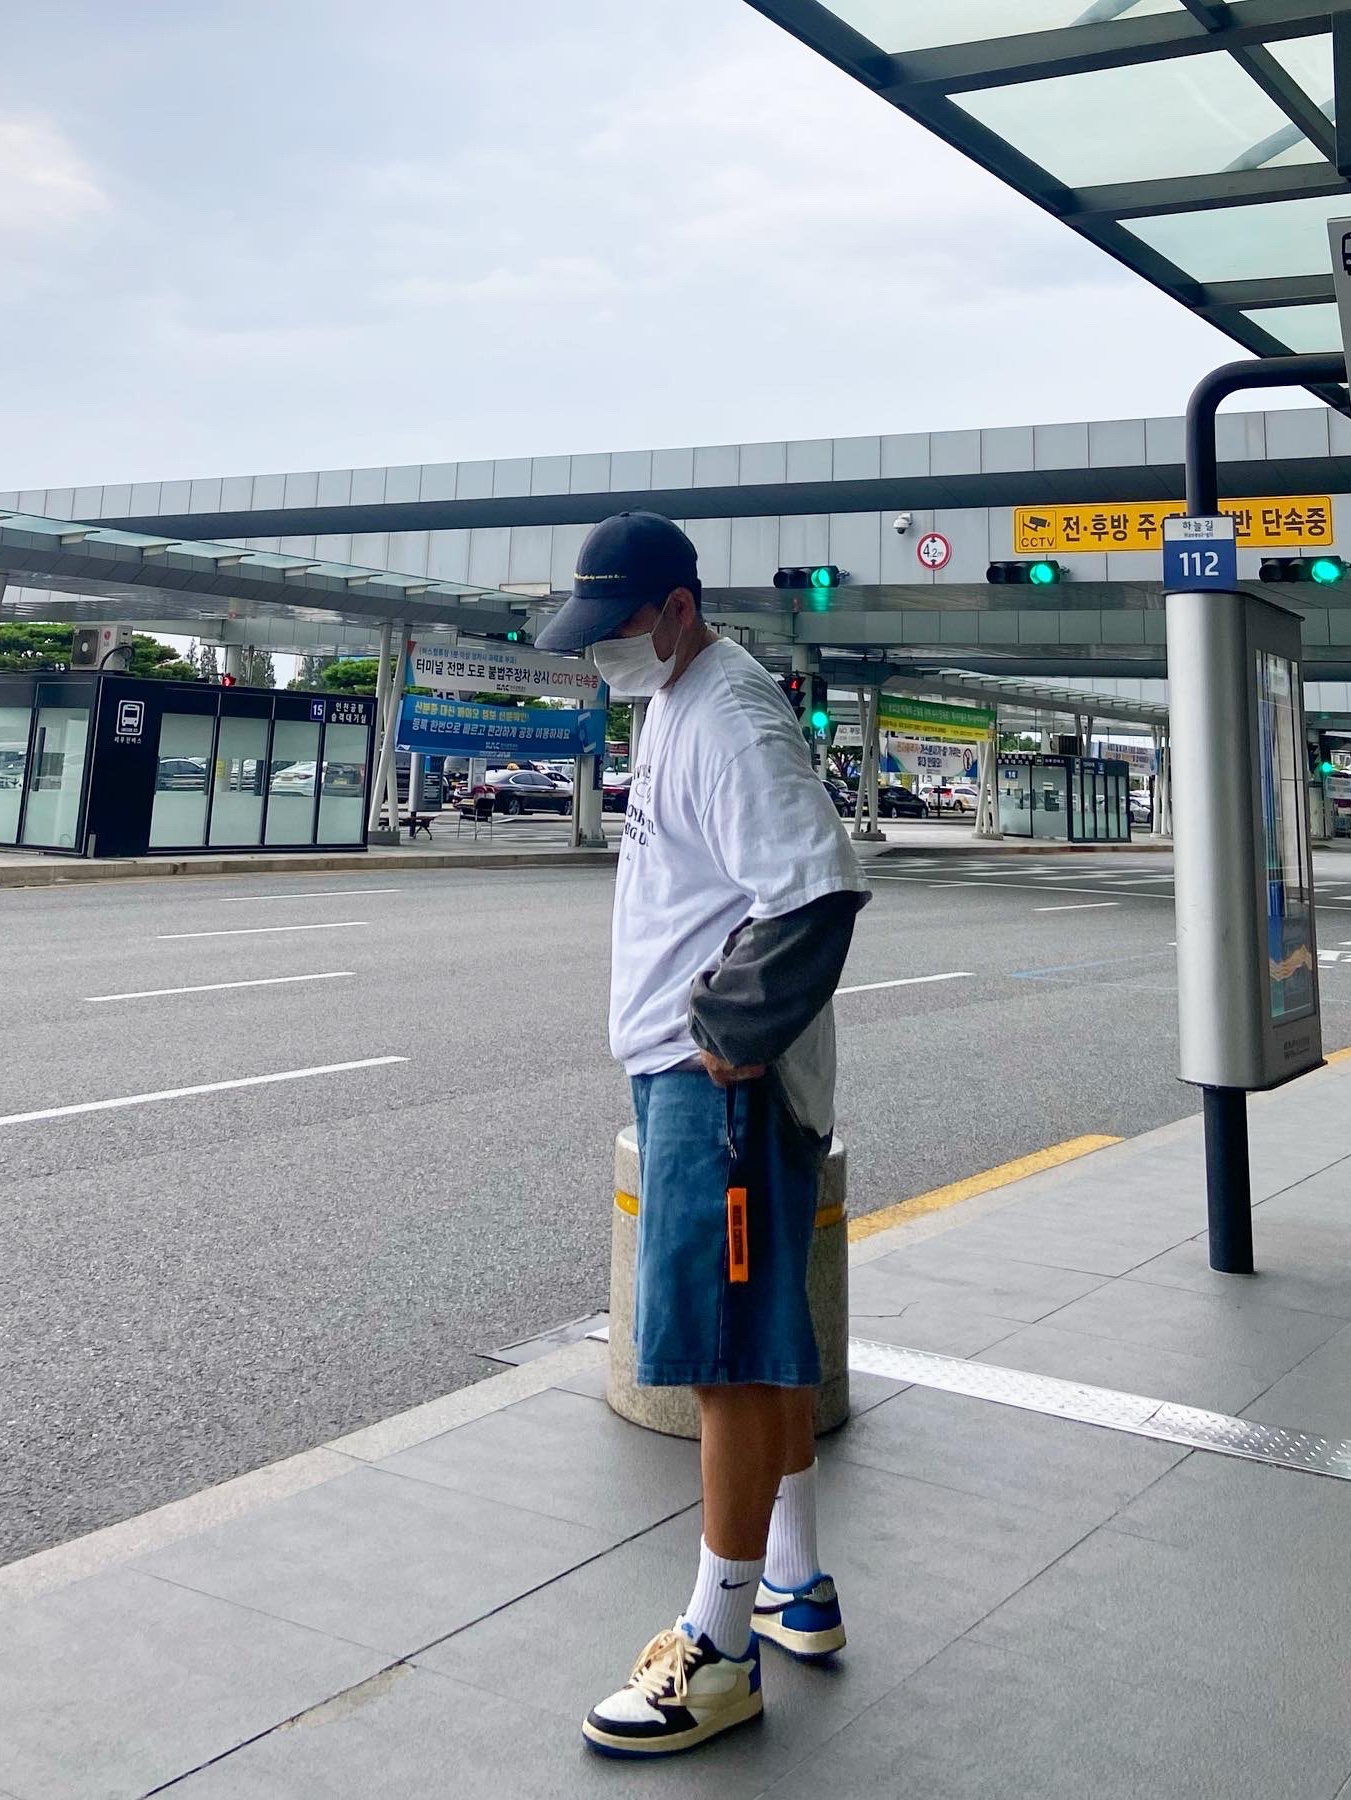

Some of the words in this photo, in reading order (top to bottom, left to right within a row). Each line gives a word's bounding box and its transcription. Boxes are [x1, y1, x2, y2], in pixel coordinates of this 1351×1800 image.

[1062, 514, 1129, 541] 전·후방
[1262, 507, 1327, 537] 단속중
[1182, 520, 1213, 532] 하늘길
[1021, 537, 1055, 548] CCTV
[1179, 551, 1219, 577] 112
[416, 658, 443, 675] 터미널
[447, 661, 464, 677] 전면
[467, 664, 485, 678] 도로
[488, 665, 531, 684] 불법주정차
[533, 670, 550, 685] 상시
[551, 672, 574, 686] CCTV
[575, 673, 598, 688] 단속중
[313, 704, 323, 716] 15
[335, 702, 364, 714] 인천공항
